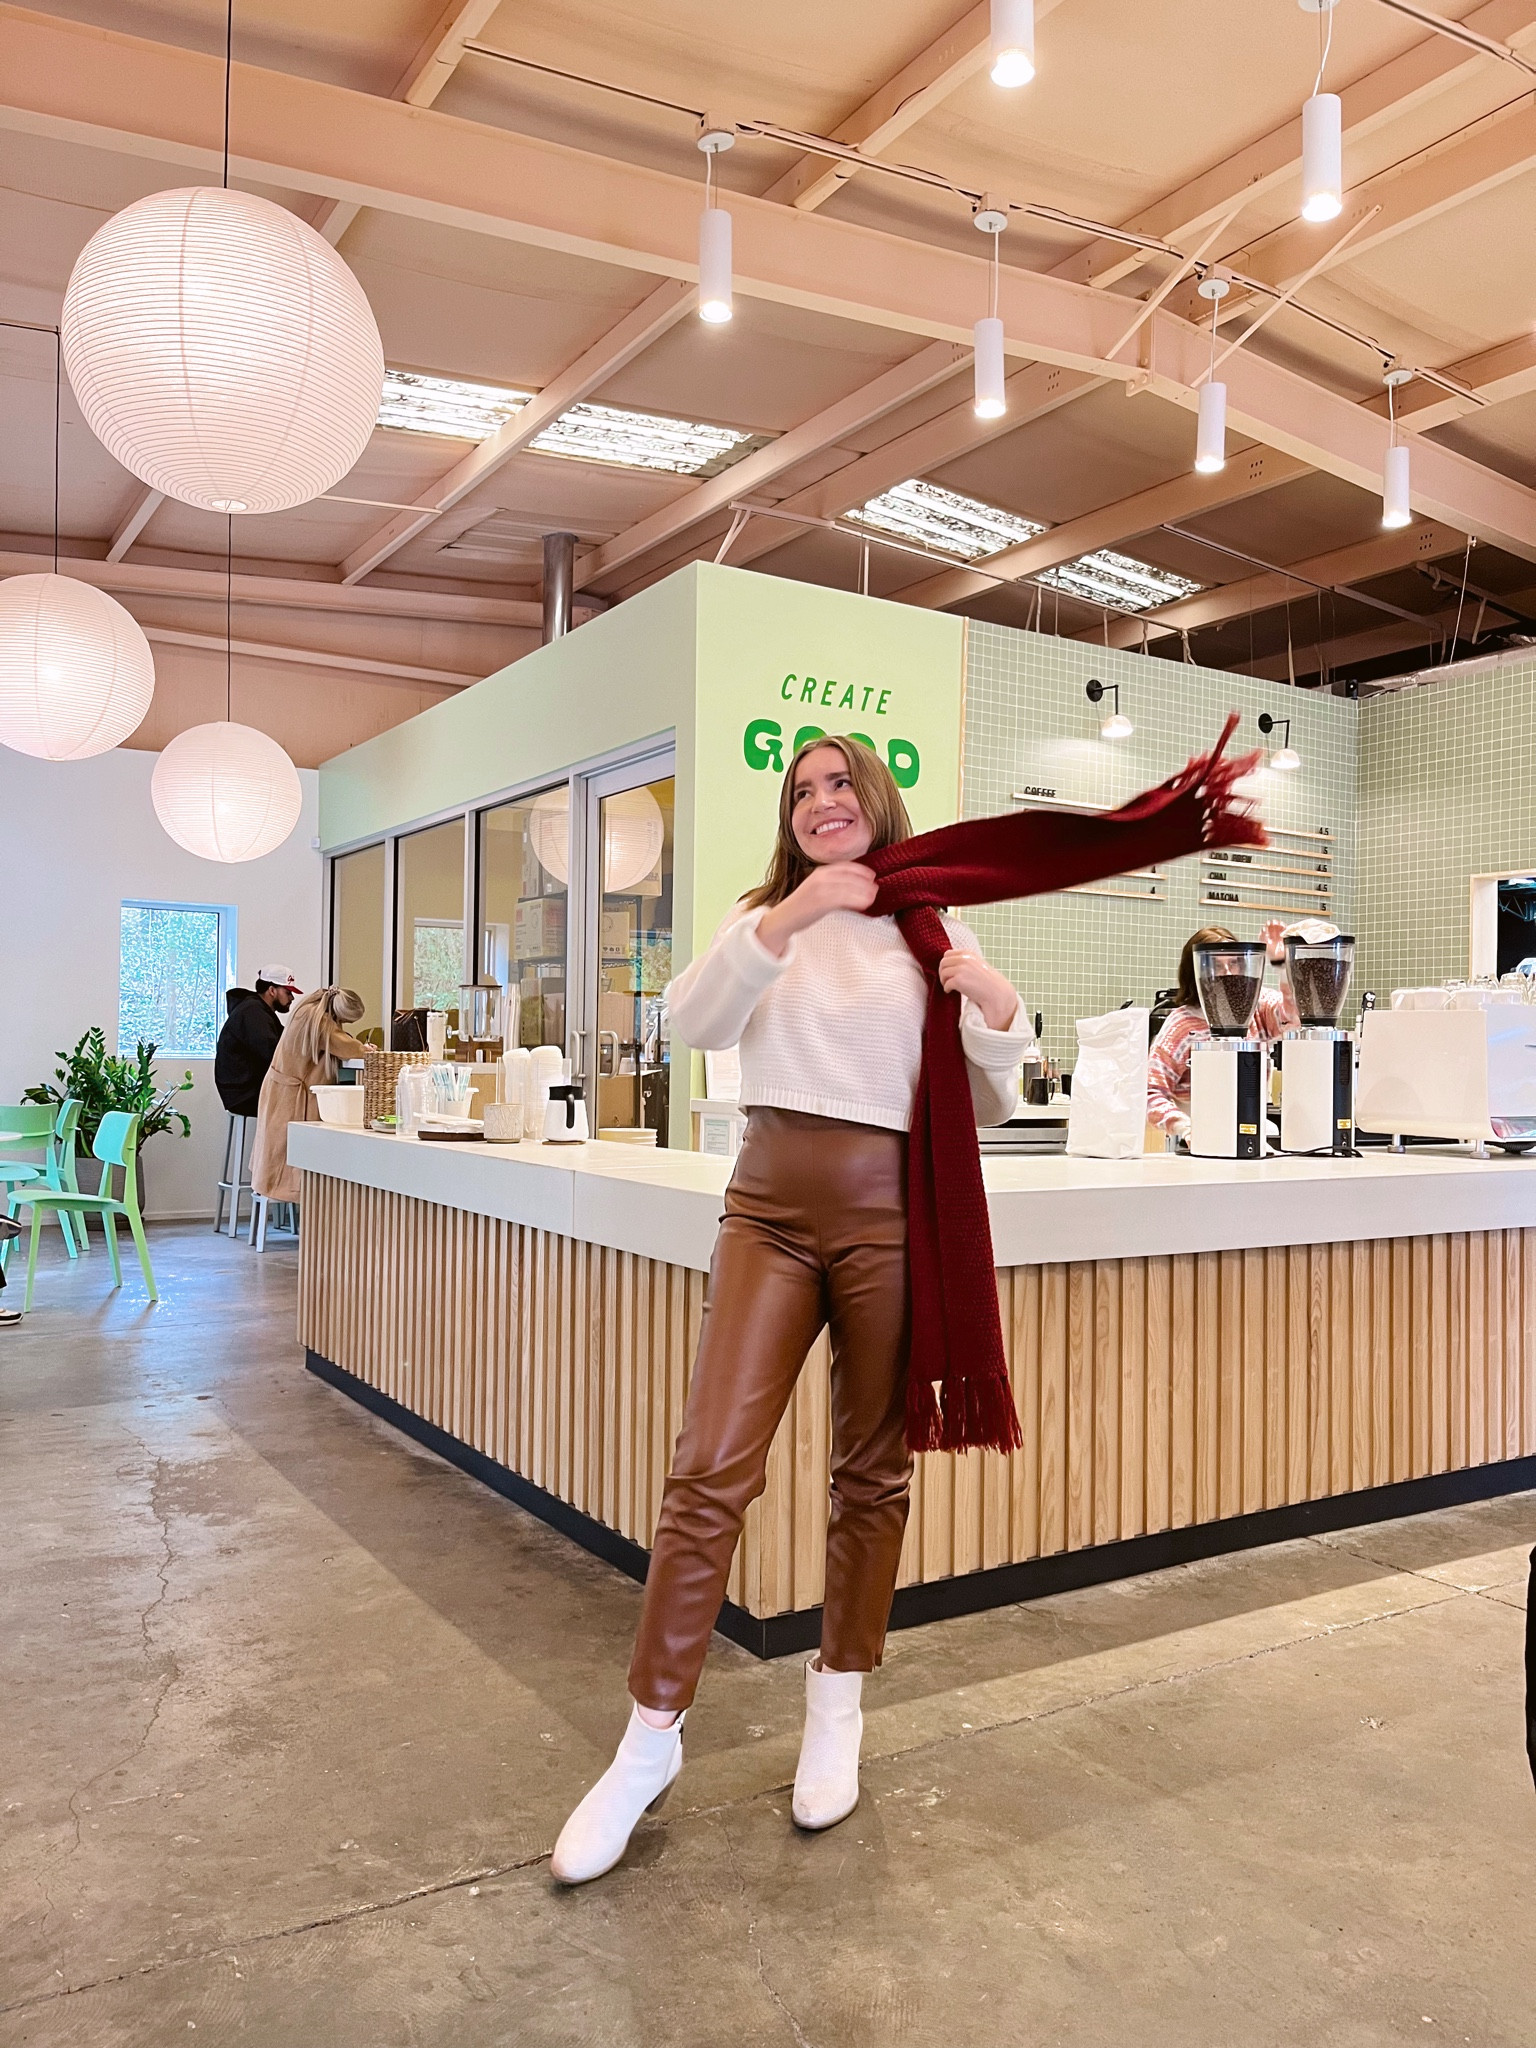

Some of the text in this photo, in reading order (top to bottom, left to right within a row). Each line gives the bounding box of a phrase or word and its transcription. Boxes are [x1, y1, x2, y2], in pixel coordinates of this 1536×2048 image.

[781, 674, 892, 715] CREATE
[744, 719, 920, 789] GD
[1024, 786, 1057, 798] COFFEE
[1318, 827, 1329, 836] 4.5
[1322, 846, 1328, 855] 5
[1208, 891, 1327, 912] MATCHA 5
